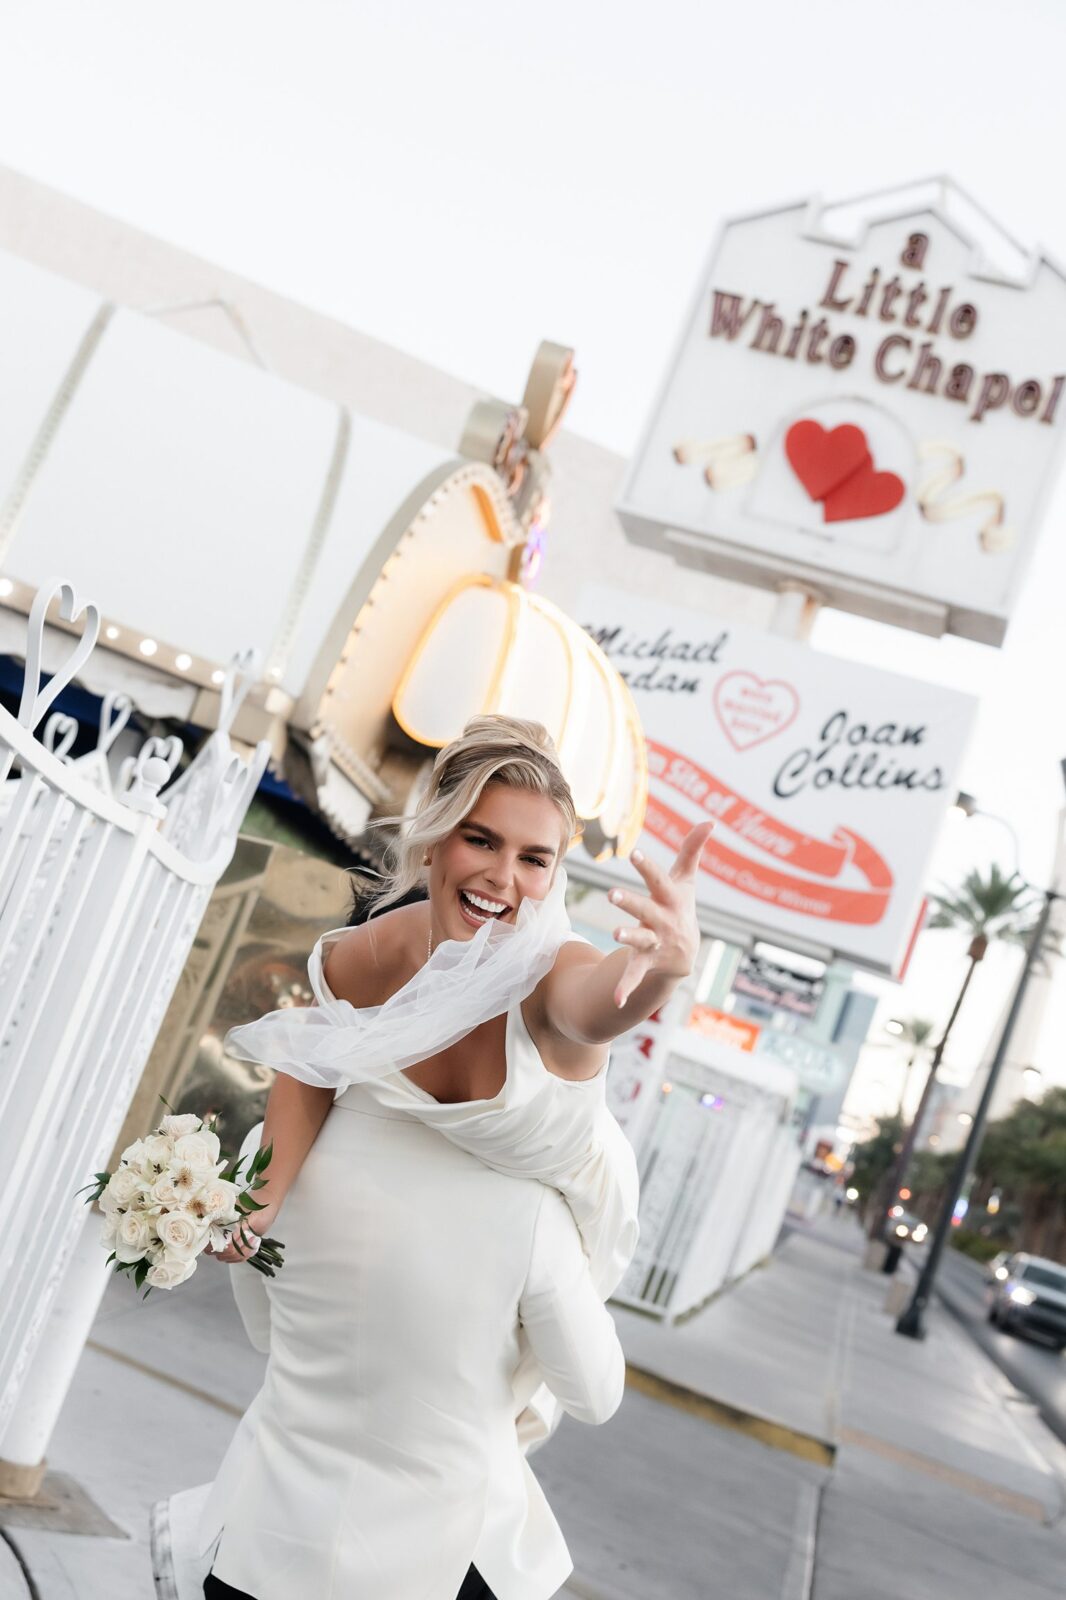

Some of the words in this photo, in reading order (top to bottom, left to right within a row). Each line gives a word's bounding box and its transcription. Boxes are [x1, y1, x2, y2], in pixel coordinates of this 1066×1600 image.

[902, 233, 928, 271] a
[819, 259, 978, 339] Little
[709, 289, 857, 370] White
[874, 333, 1066, 425] Chapel
[580, 626, 728, 663] Michael
[819, 710, 926, 762] Joan
[773, 748, 945, 798] Collins
